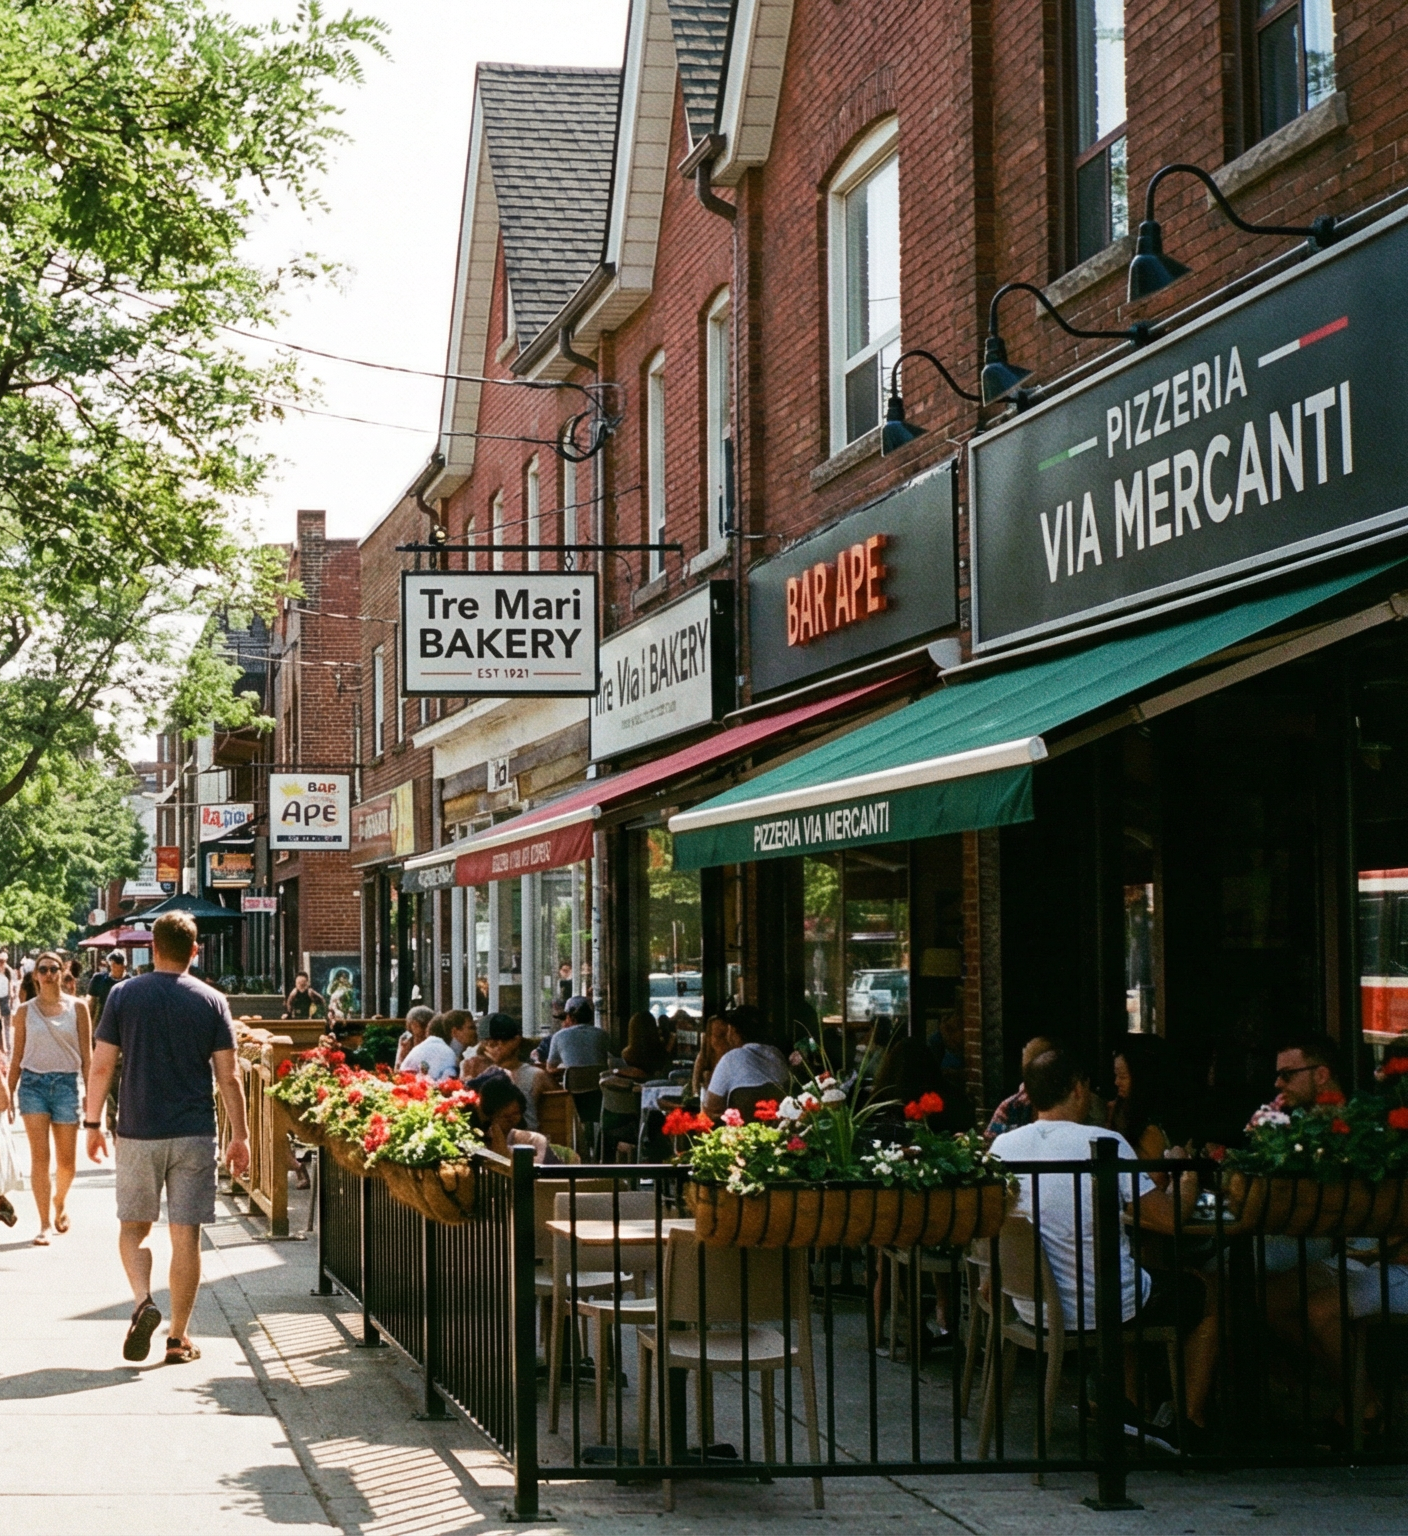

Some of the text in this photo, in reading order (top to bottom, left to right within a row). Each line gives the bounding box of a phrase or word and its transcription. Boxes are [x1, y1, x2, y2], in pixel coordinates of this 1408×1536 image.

[1106, 346, 1248, 459] PIZZERIA
[1040, 379, 1353, 584] VIA MERCANTI
[419, 588, 582, 620] Tre Mari
[786, 533, 887, 647] BAR APE
[419, 628, 582, 659] BAKERY
[649, 617, 709, 694] BAKERY
[477, 668, 530, 679] EST 1921
[281, 800, 337, 827] APE
[754, 801, 890, 852] PIZZERIA VIA MERCANTI
